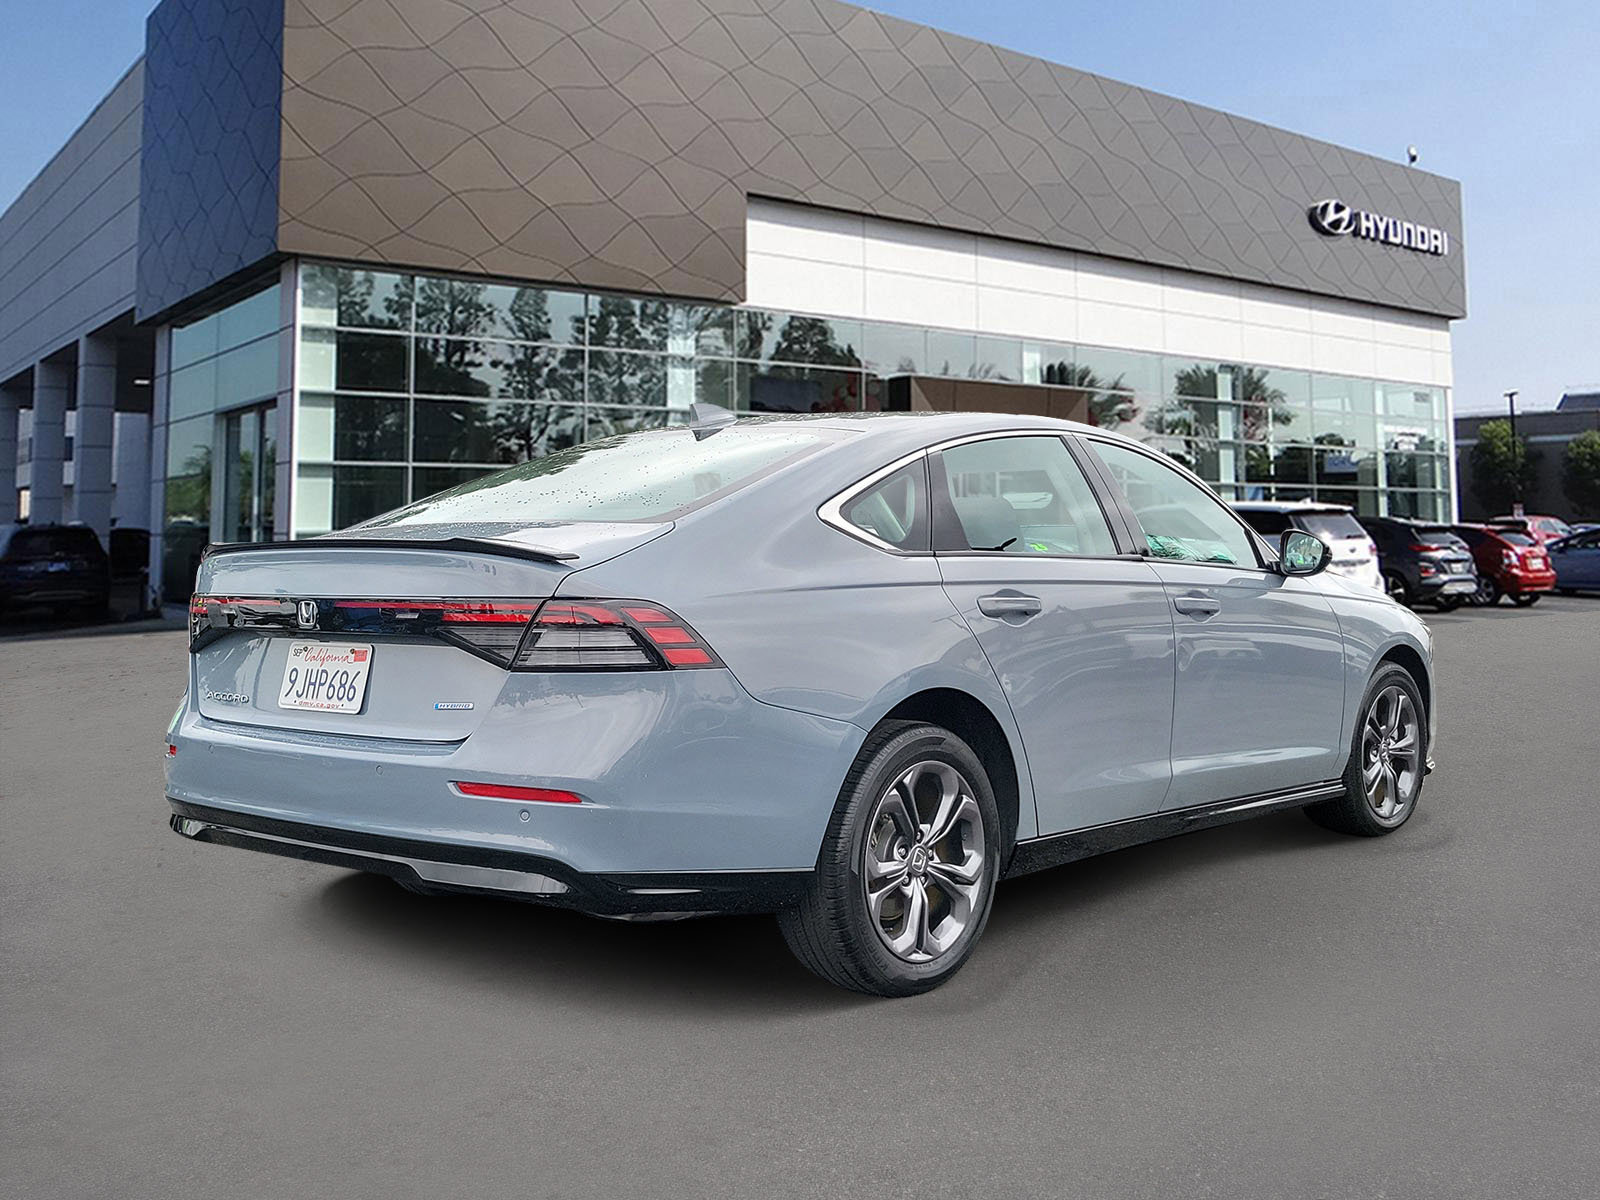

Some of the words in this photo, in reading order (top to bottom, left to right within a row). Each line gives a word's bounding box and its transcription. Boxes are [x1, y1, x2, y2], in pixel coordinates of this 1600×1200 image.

[1359, 211, 1449, 256] HYUNDAI
[292, 648, 304, 658] SEP
[304, 646, 354, 667] California
[284, 667, 361, 702] 9JHP686
[206, 691, 250, 704] ACCORD
